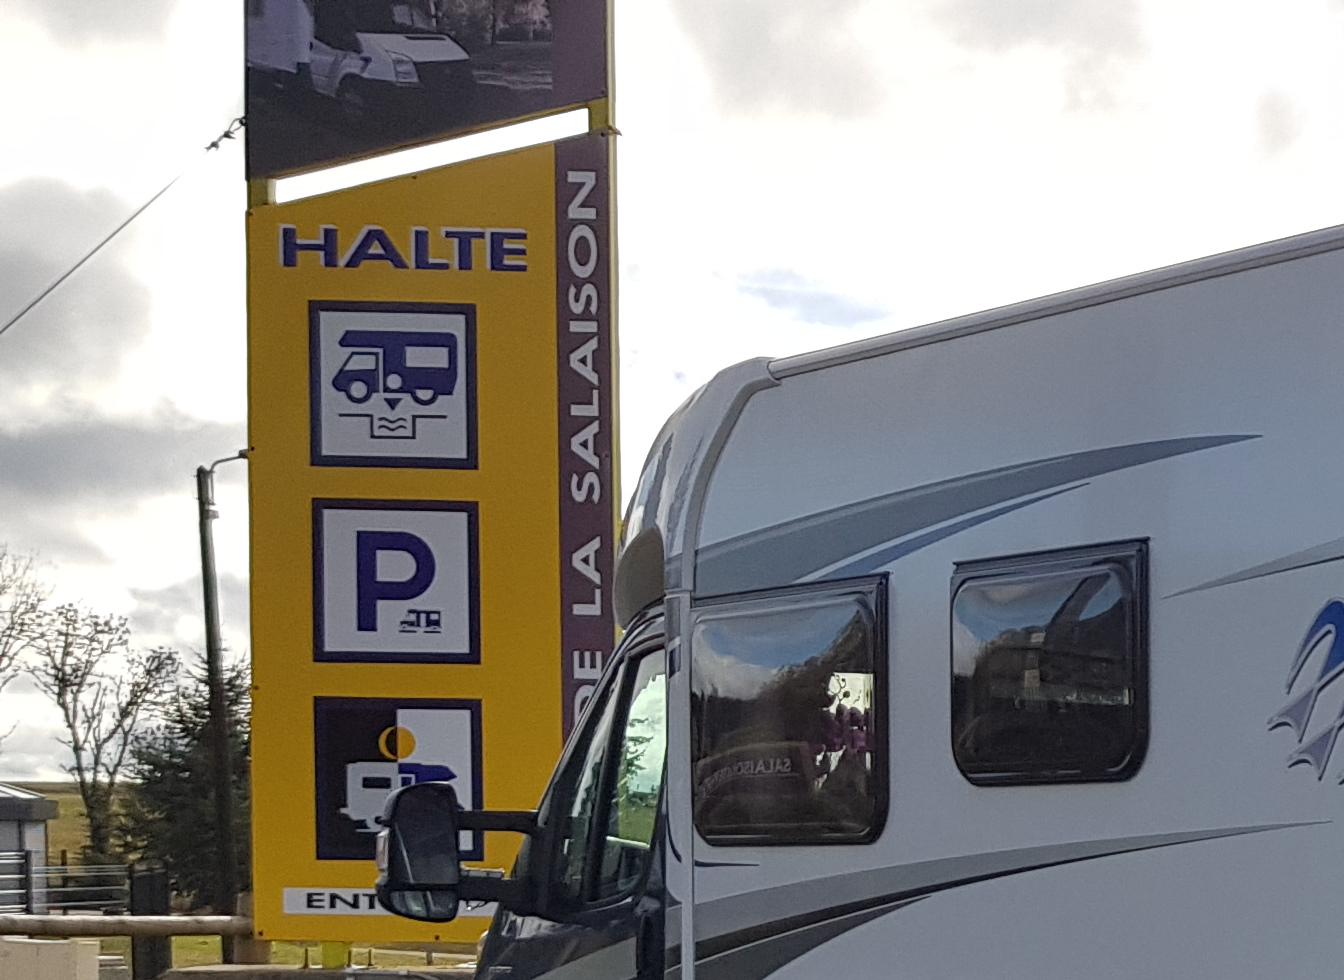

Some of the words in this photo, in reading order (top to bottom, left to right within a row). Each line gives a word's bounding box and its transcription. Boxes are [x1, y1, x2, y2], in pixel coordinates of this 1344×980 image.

[279, 224, 528, 272] HALTE
[567, 170, 600, 505] SALAISON
[356, 530, 436, 631] P
[571, 536, 602, 616] LA
[306, 891, 378, 910] ENT
